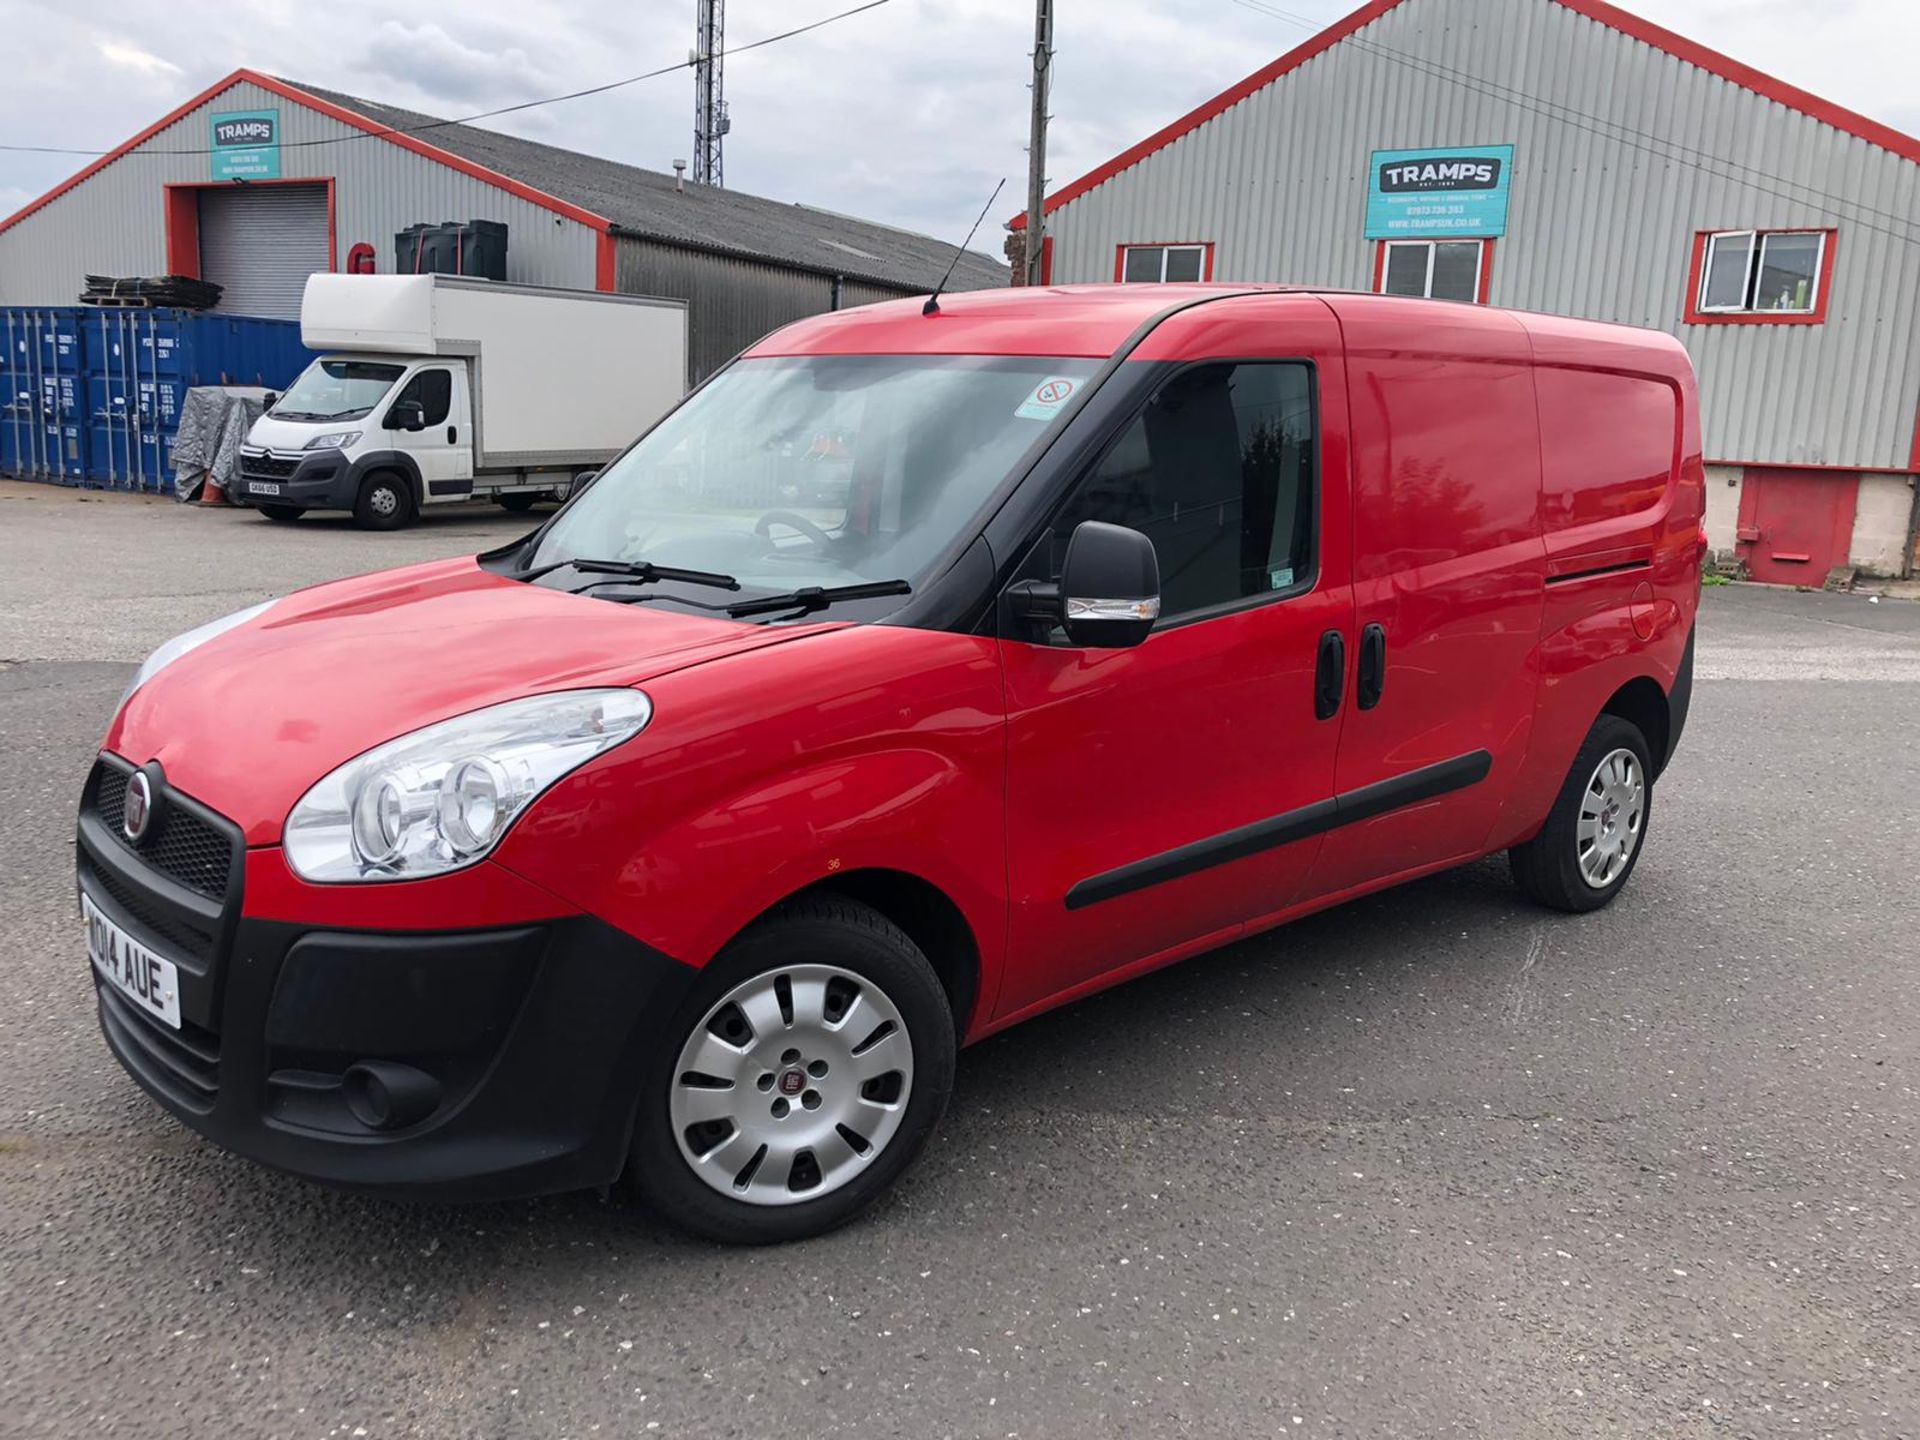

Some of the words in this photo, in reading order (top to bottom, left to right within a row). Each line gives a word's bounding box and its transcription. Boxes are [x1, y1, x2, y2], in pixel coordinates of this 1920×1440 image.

[217, 123, 270, 140] TRAMPS
[1386, 164, 1493, 185] TRAMPS
[124, 942, 164, 1009] AUE
